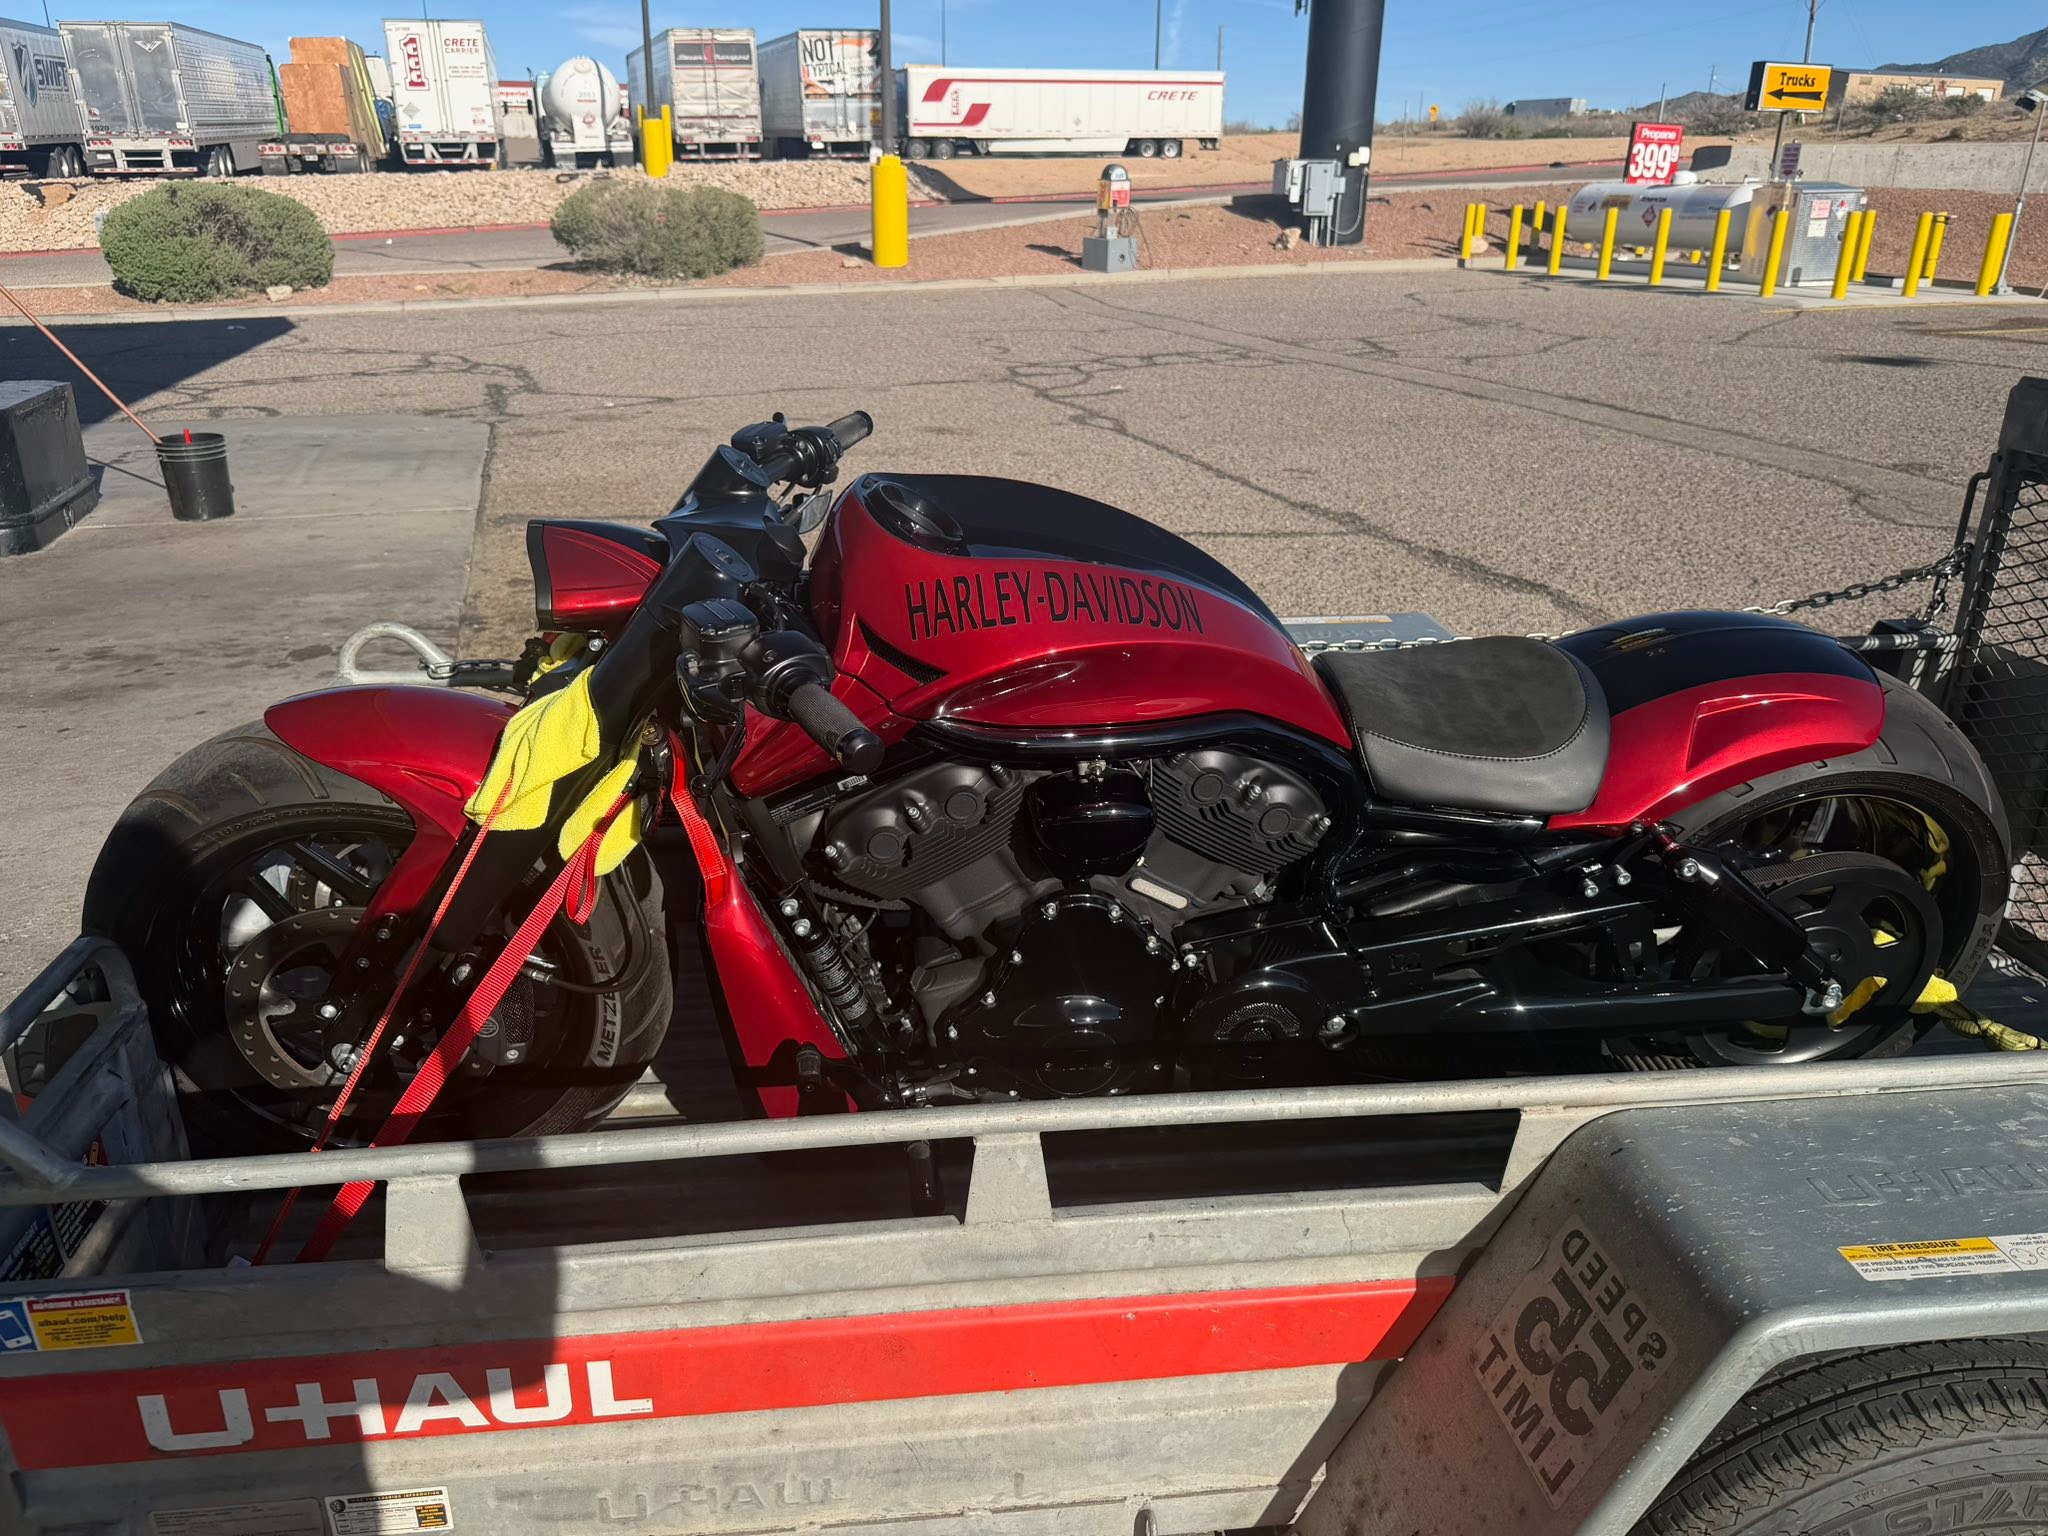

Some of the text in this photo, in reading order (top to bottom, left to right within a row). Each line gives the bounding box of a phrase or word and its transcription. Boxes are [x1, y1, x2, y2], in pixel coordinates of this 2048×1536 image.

[444, 38, 478, 47] CRETE
[801, 38, 834, 62] NOT
[35, 58, 68, 87] SWIFT
[1780, 72, 1816, 87] Trucks
[1147, 90, 1198, 101] CRETE
[1641, 128, 1677, 140] Propane
[904, 570, 1204, 642] HARLEY-DAVIDSON
[1954, 921, 1996, 985] ULTRA
[590, 944, 618, 1062] METZEER
[1867, 1240, 1960, 1252] TIRE PRESSURE
[1562, 1229, 1667, 1371] SPEED
[38, 1313, 127, 1328] uhaul.com/help
[1514, 1266, 1635, 1436] 55
[137, 1360, 654, 1452] U-HAUL
[1479, 1333, 1576, 1496] LIMIT
